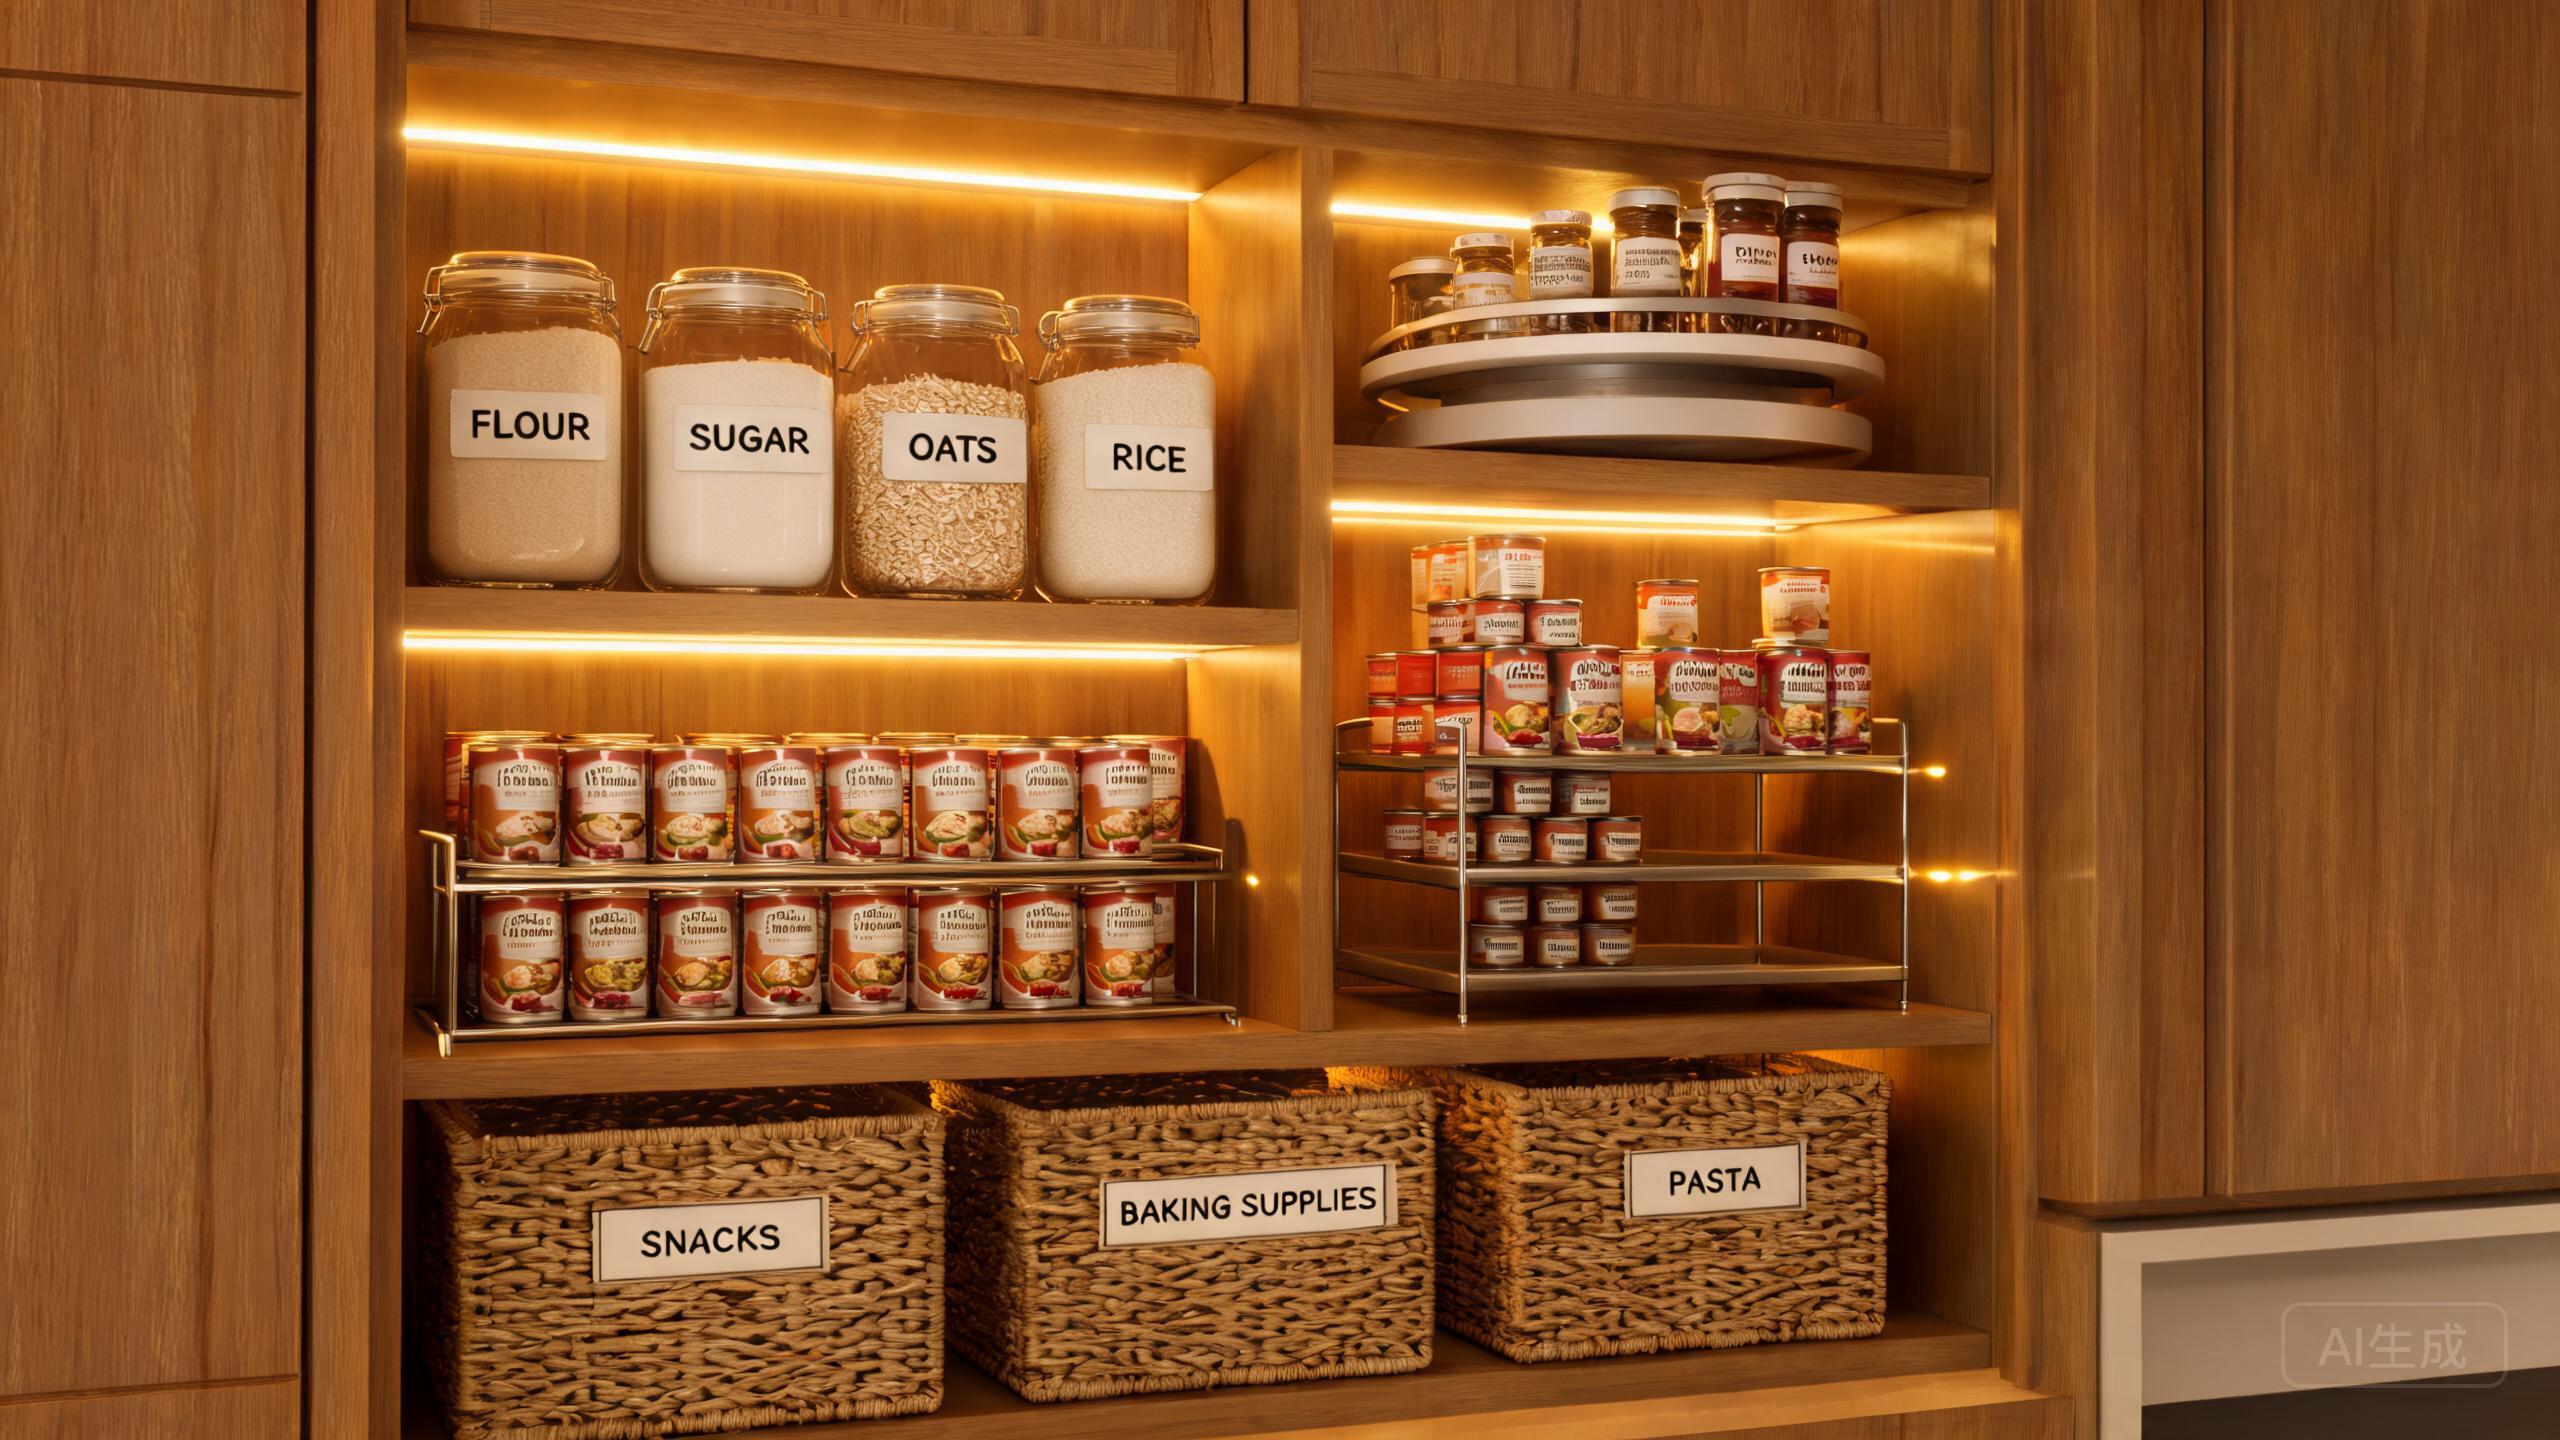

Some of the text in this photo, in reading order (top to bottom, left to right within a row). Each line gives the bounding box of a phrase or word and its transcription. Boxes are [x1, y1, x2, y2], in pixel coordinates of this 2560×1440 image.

[472, 409, 591, 441] FLOUR
[689, 423, 810, 455] SUGAR
[909, 432, 998, 464] OATS
[1112, 443, 1188, 474] RICE
[1668, 1166, 1762, 1196] PASTA
[1120, 1186, 1378, 1226] BAKING SUPPLIES
[640, 1224, 780, 1258] SNACKS
